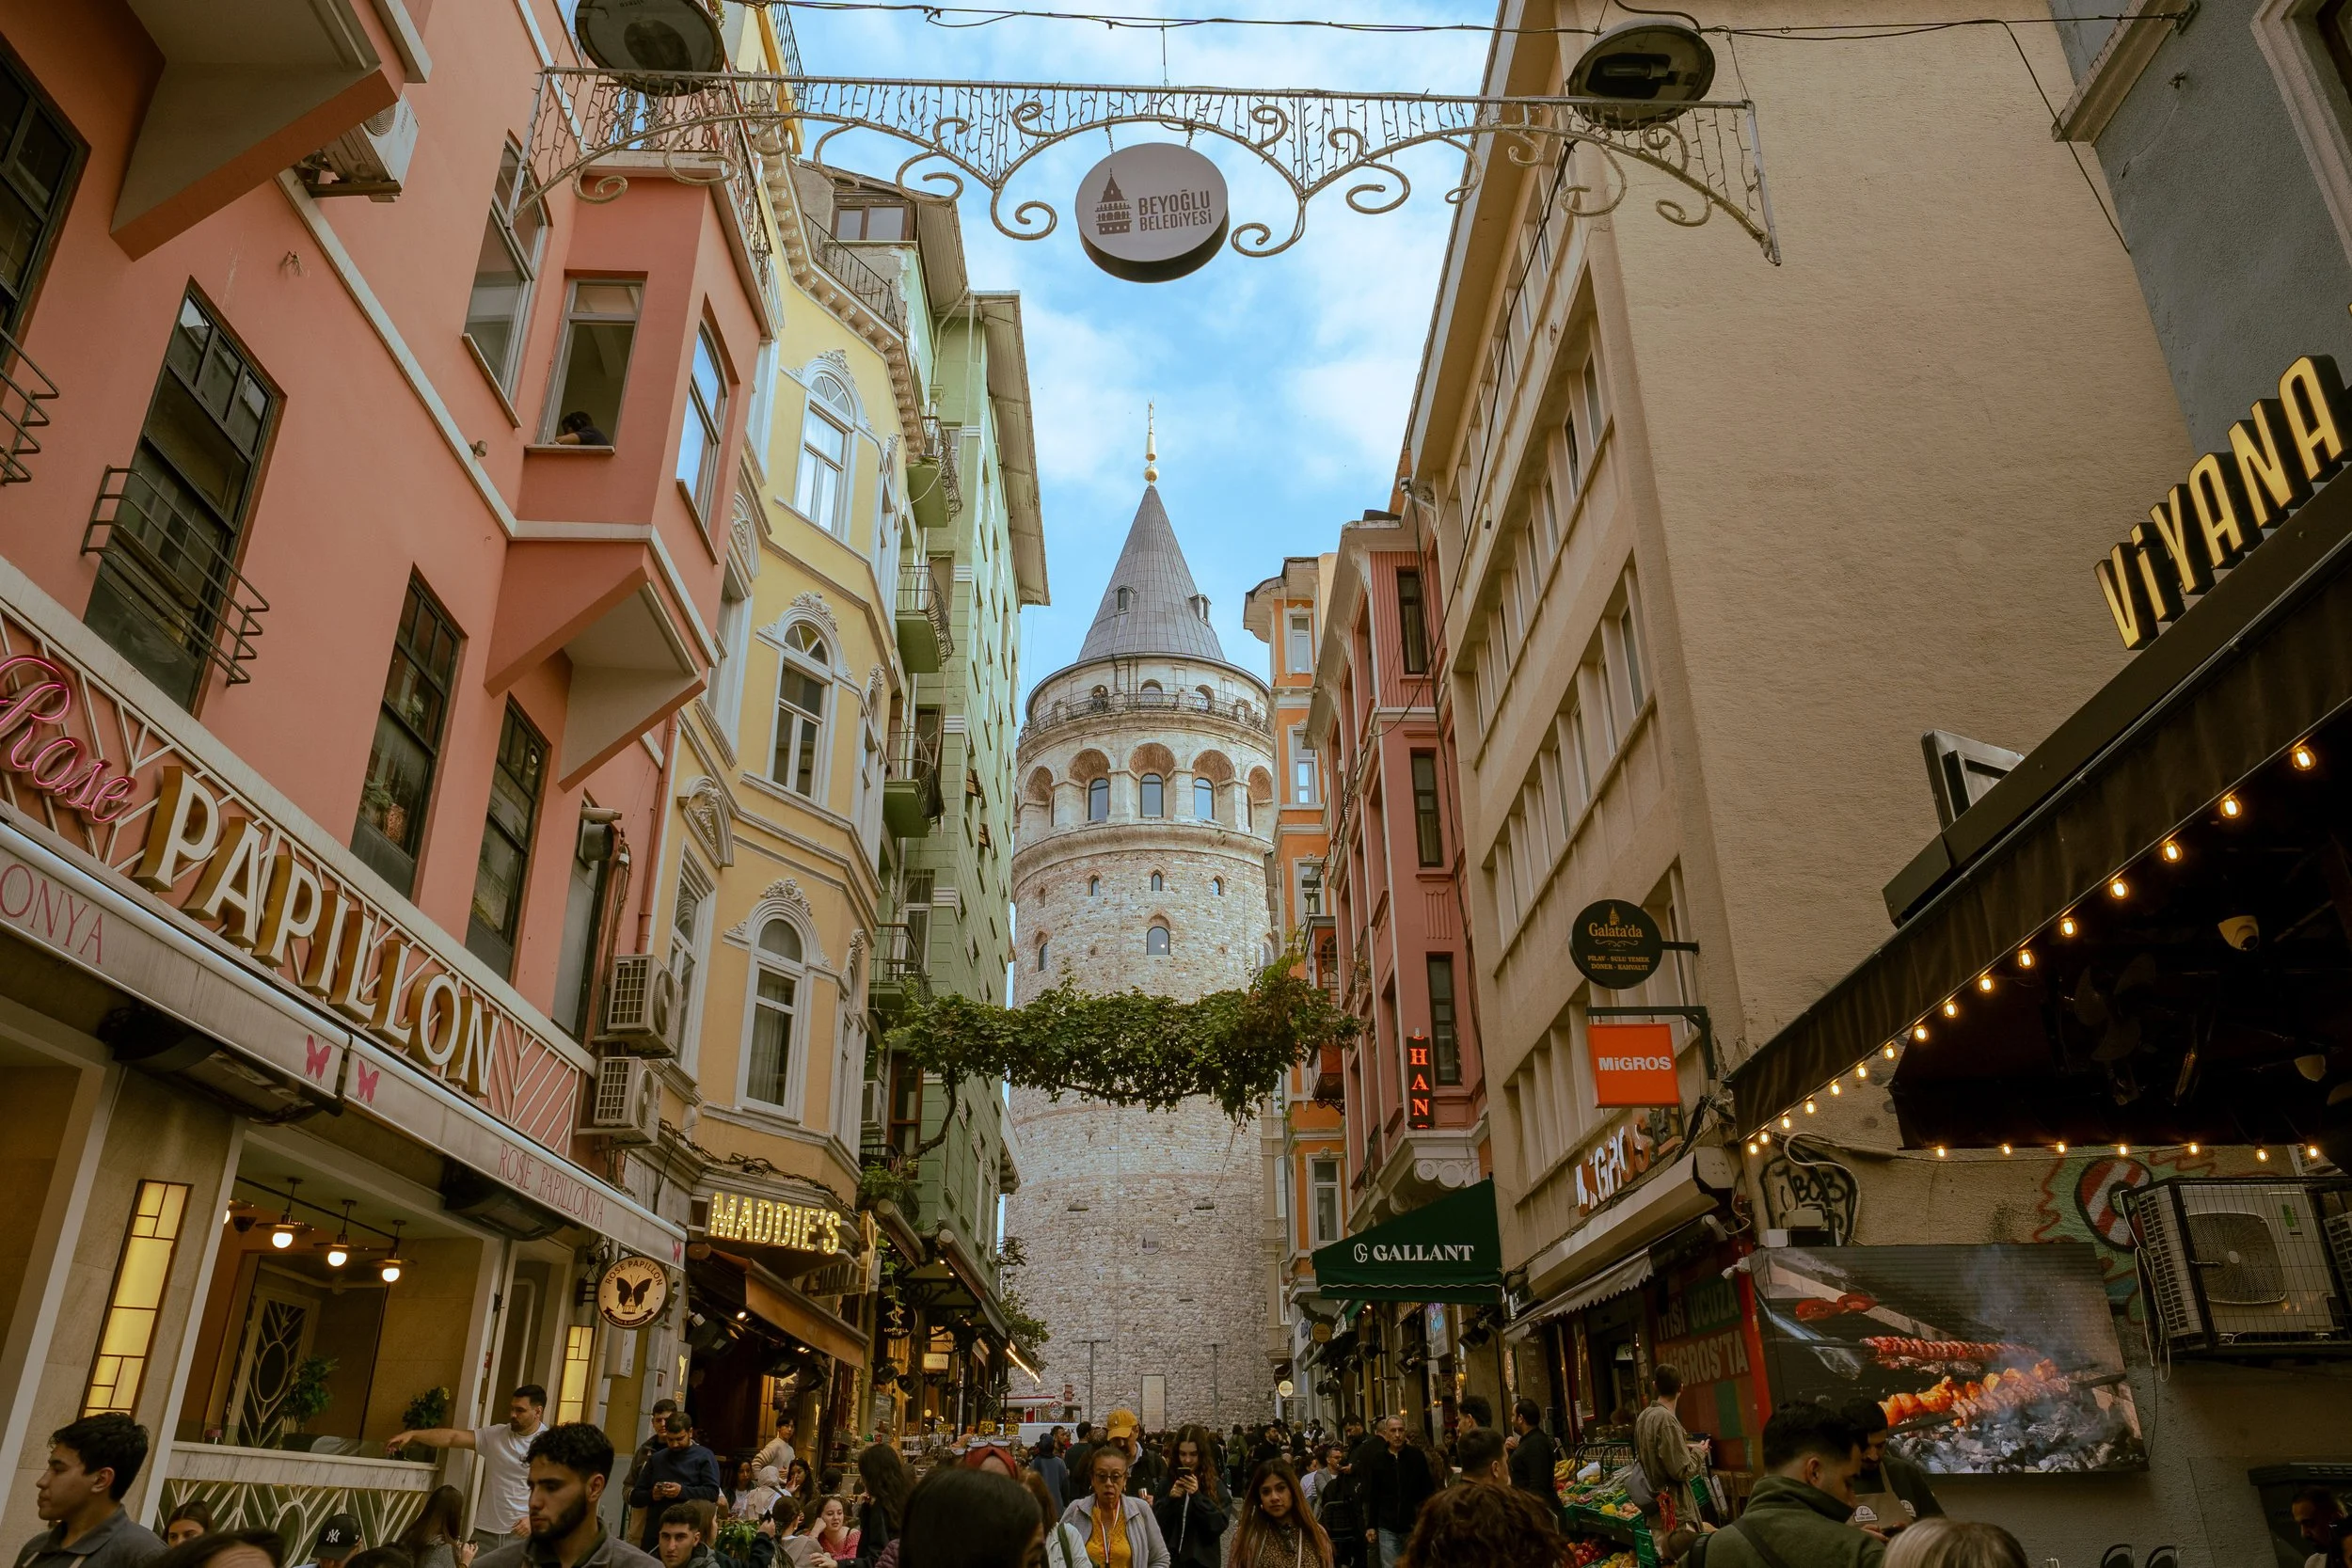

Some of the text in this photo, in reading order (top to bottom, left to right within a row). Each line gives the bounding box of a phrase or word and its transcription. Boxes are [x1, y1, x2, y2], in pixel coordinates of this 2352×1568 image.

[1138, 189, 1211, 216] BEYOĞLU
[135, 766, 501, 1097] PAPILLON
[1588, 922, 1644, 938] Galata'da
[1409, 1048, 1429, 1117] HAN
[498, 1143, 604, 1227] ROSE PAPILLONYA
[708, 1192, 841, 1256] MADDIE'S
[1373, 1243, 1474, 1262] GALLANT
[605, 1259, 662, 1286] ROSE PAPILLON
[326, 1528, 341, 1544] NY
